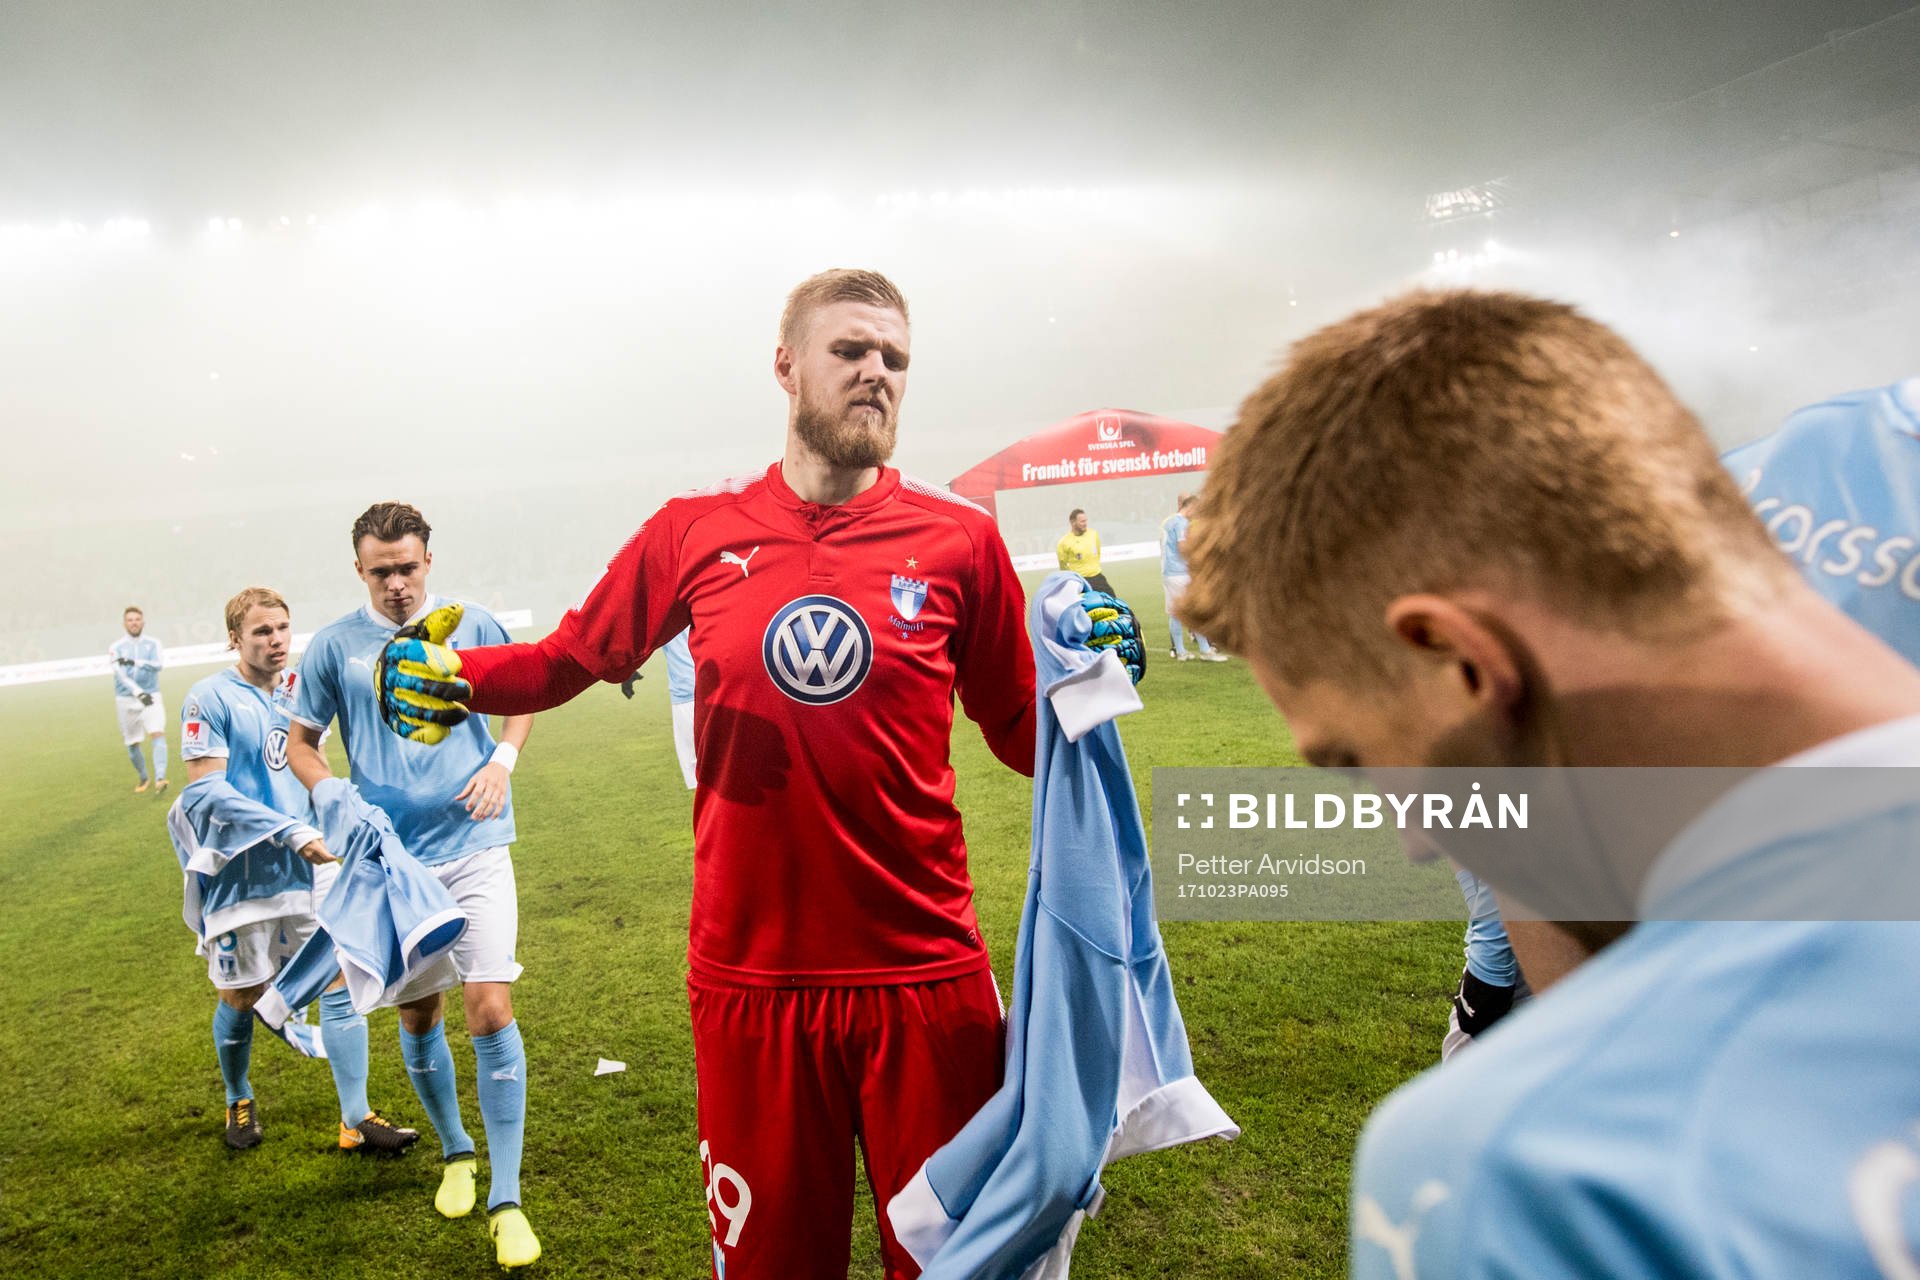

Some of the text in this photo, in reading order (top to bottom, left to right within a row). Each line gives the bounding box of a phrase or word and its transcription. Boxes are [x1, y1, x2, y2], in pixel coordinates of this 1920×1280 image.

[1088, 440, 1136, 451] SVENSKA SPEL
[1022, 447, 1207, 481] Framåt för svensk fotboll!
